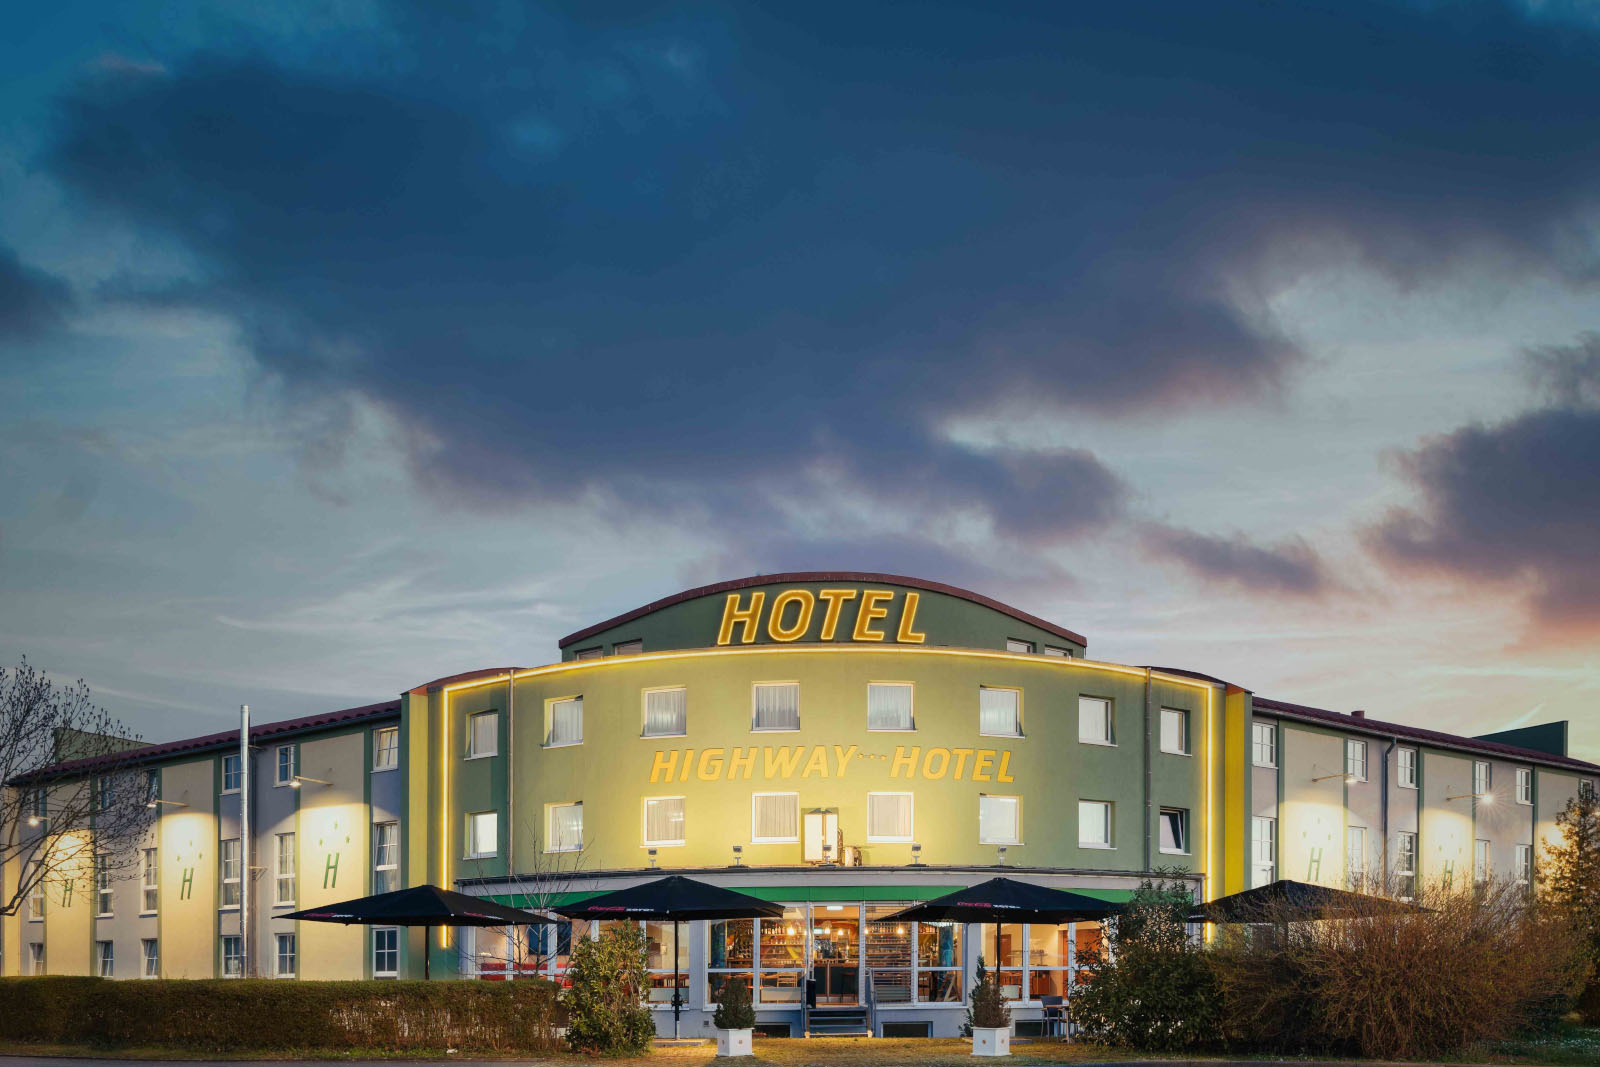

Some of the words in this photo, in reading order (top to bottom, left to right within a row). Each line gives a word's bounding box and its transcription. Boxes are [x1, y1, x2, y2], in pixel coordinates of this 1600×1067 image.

[717, 589, 926, 646] HOTEL
[649, 744, 858, 784] HIGHWAY
[889, 745, 1015, 784] HOTEL
[323, 852, 340, 889] H
[1307, 847, 1323, 882] H
[1442, 859, 1455, 889] H
[62, 878, 74, 907] H
[180, 867, 195, 900] H
